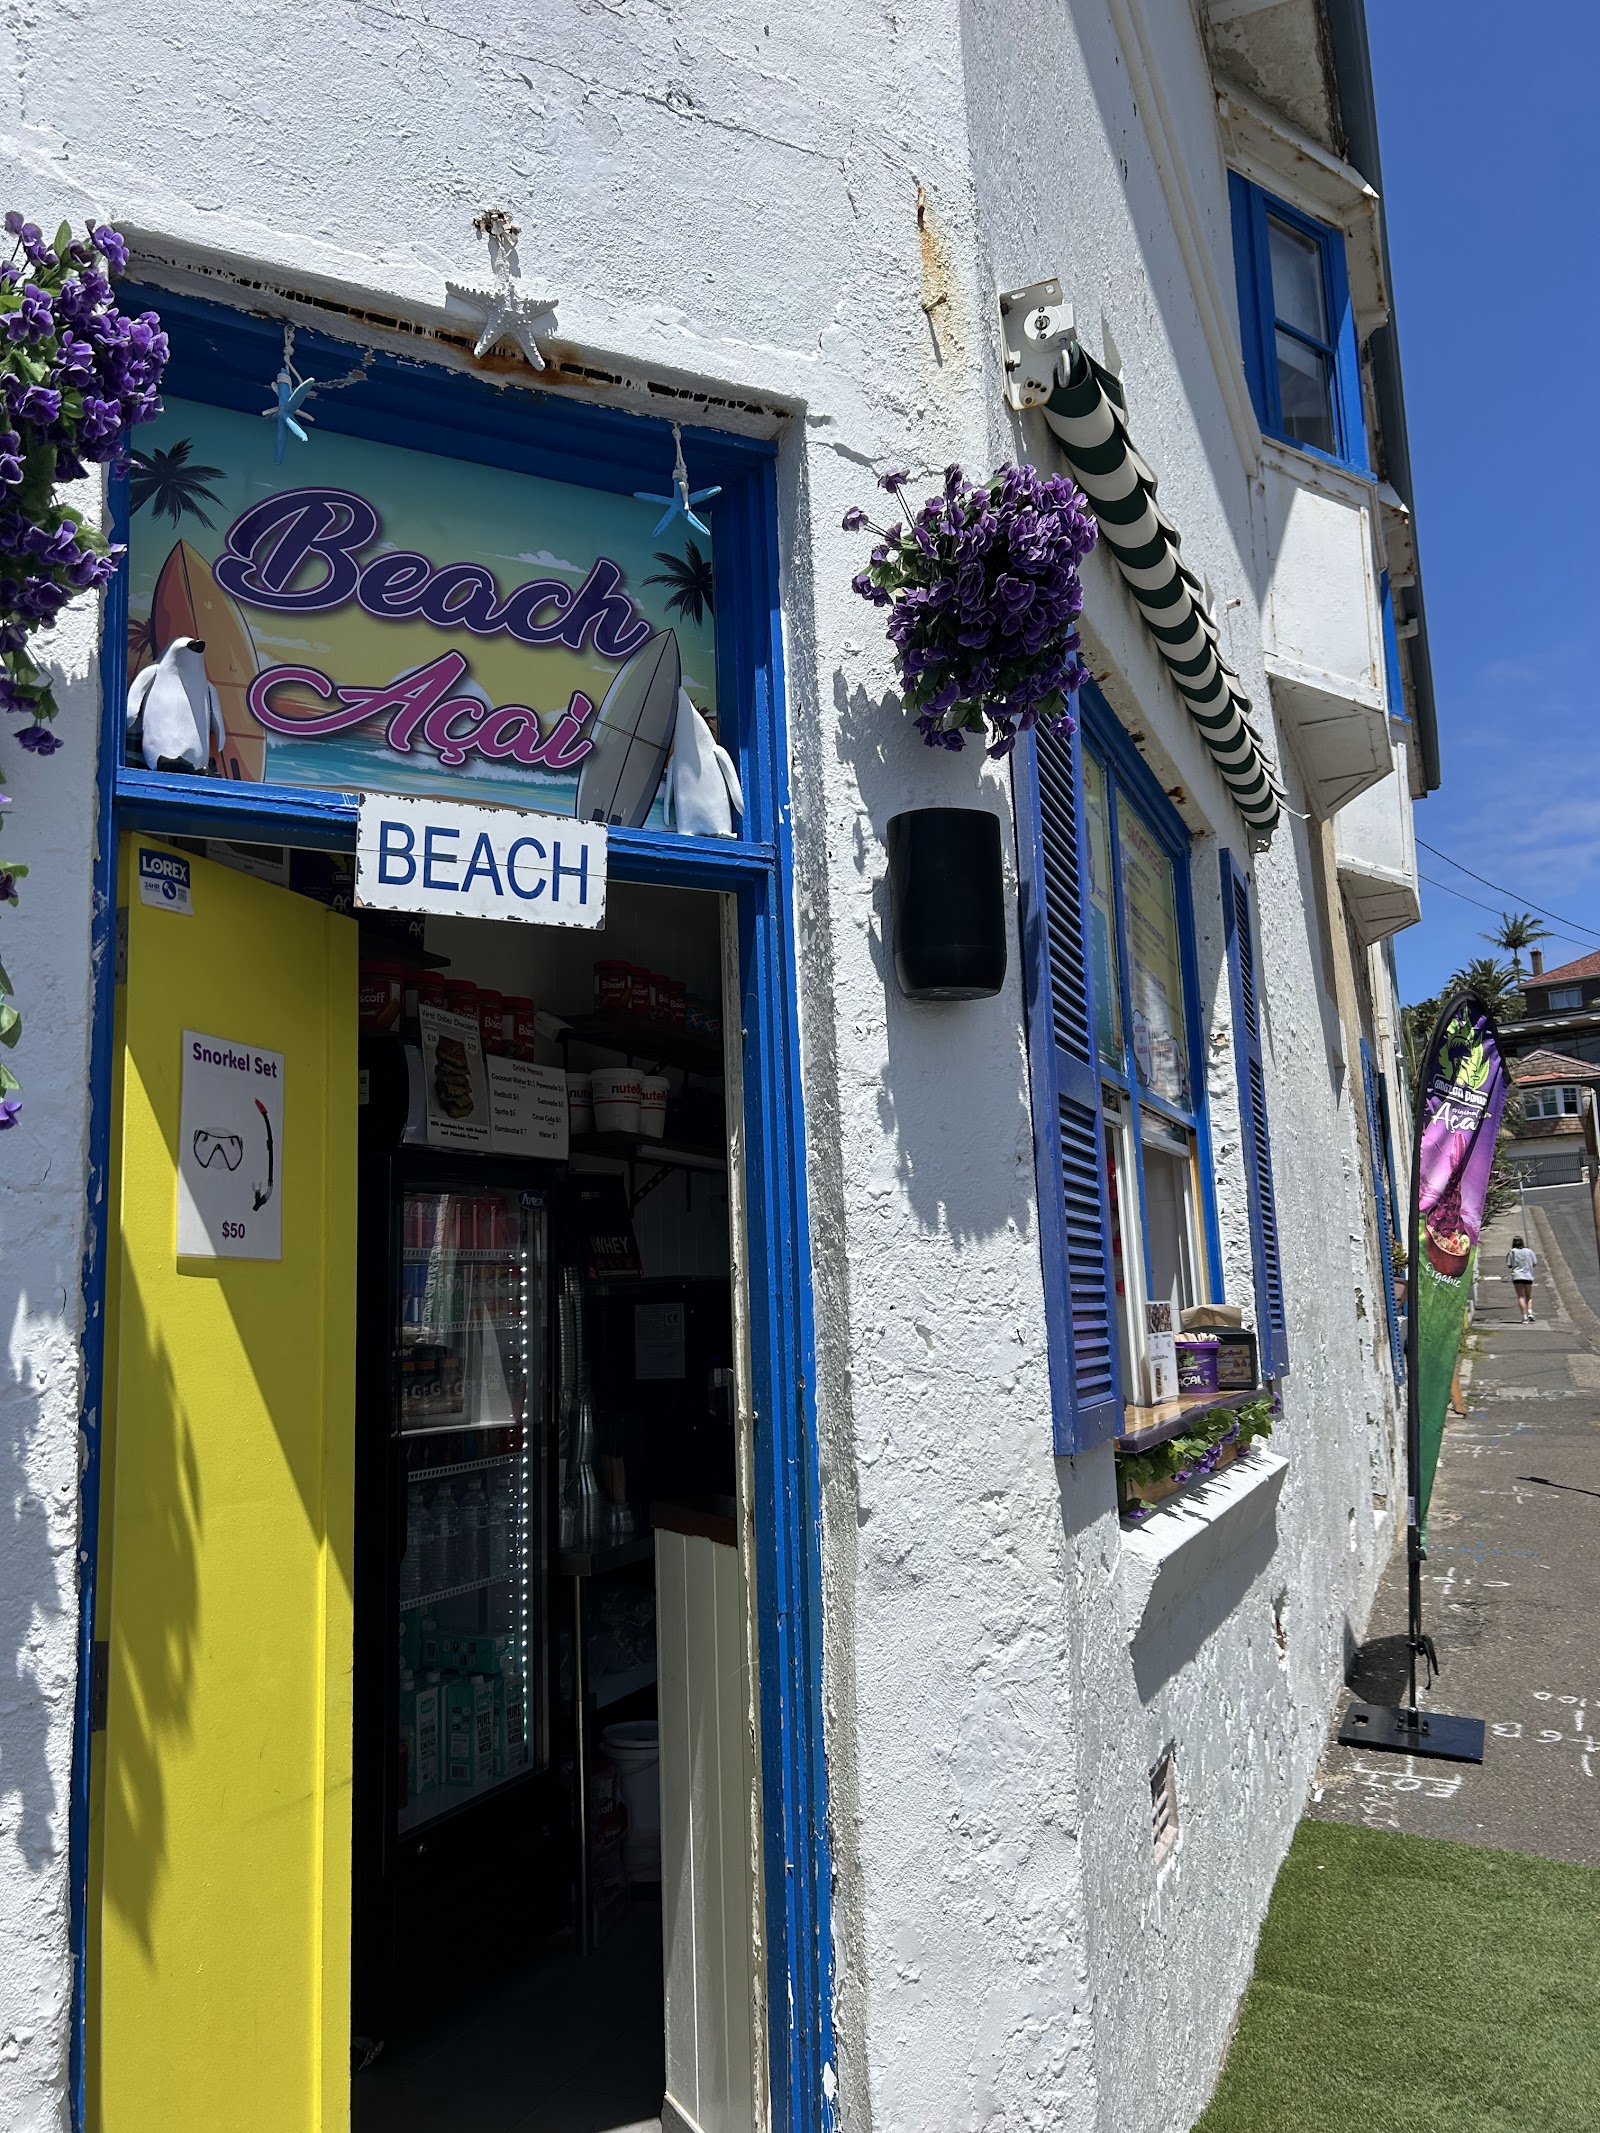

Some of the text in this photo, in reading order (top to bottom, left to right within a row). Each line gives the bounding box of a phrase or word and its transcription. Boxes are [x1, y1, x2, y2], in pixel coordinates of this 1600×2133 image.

[212, 487, 650, 659] Beach
[247, 649, 595, 769] Açai
[142, 855, 187, 882] LOREX
[378, 820, 588, 905] BEACH
[602, 980, 627, 991] Biscoff
[360, 992, 385, 1004] scoff
[484, 1017, 502, 1030] Bisc
[193, 1042, 277, 1078] Snorkel Set
[491, 1072, 512, 1083] Coconut
[611, 1083, 642, 1094] nutell
[1432, 1101, 1480, 1134] Aça
[494, 1125, 519, 1135] Kombucha
[222, 1219, 245, 1240] $50
[595, 1236, 629, 1254] WHEY
[1425, 1262, 1462, 1288] Organic
[476, 1711, 491, 1728] PURE
[507, 1703, 521, 1720] PURE
